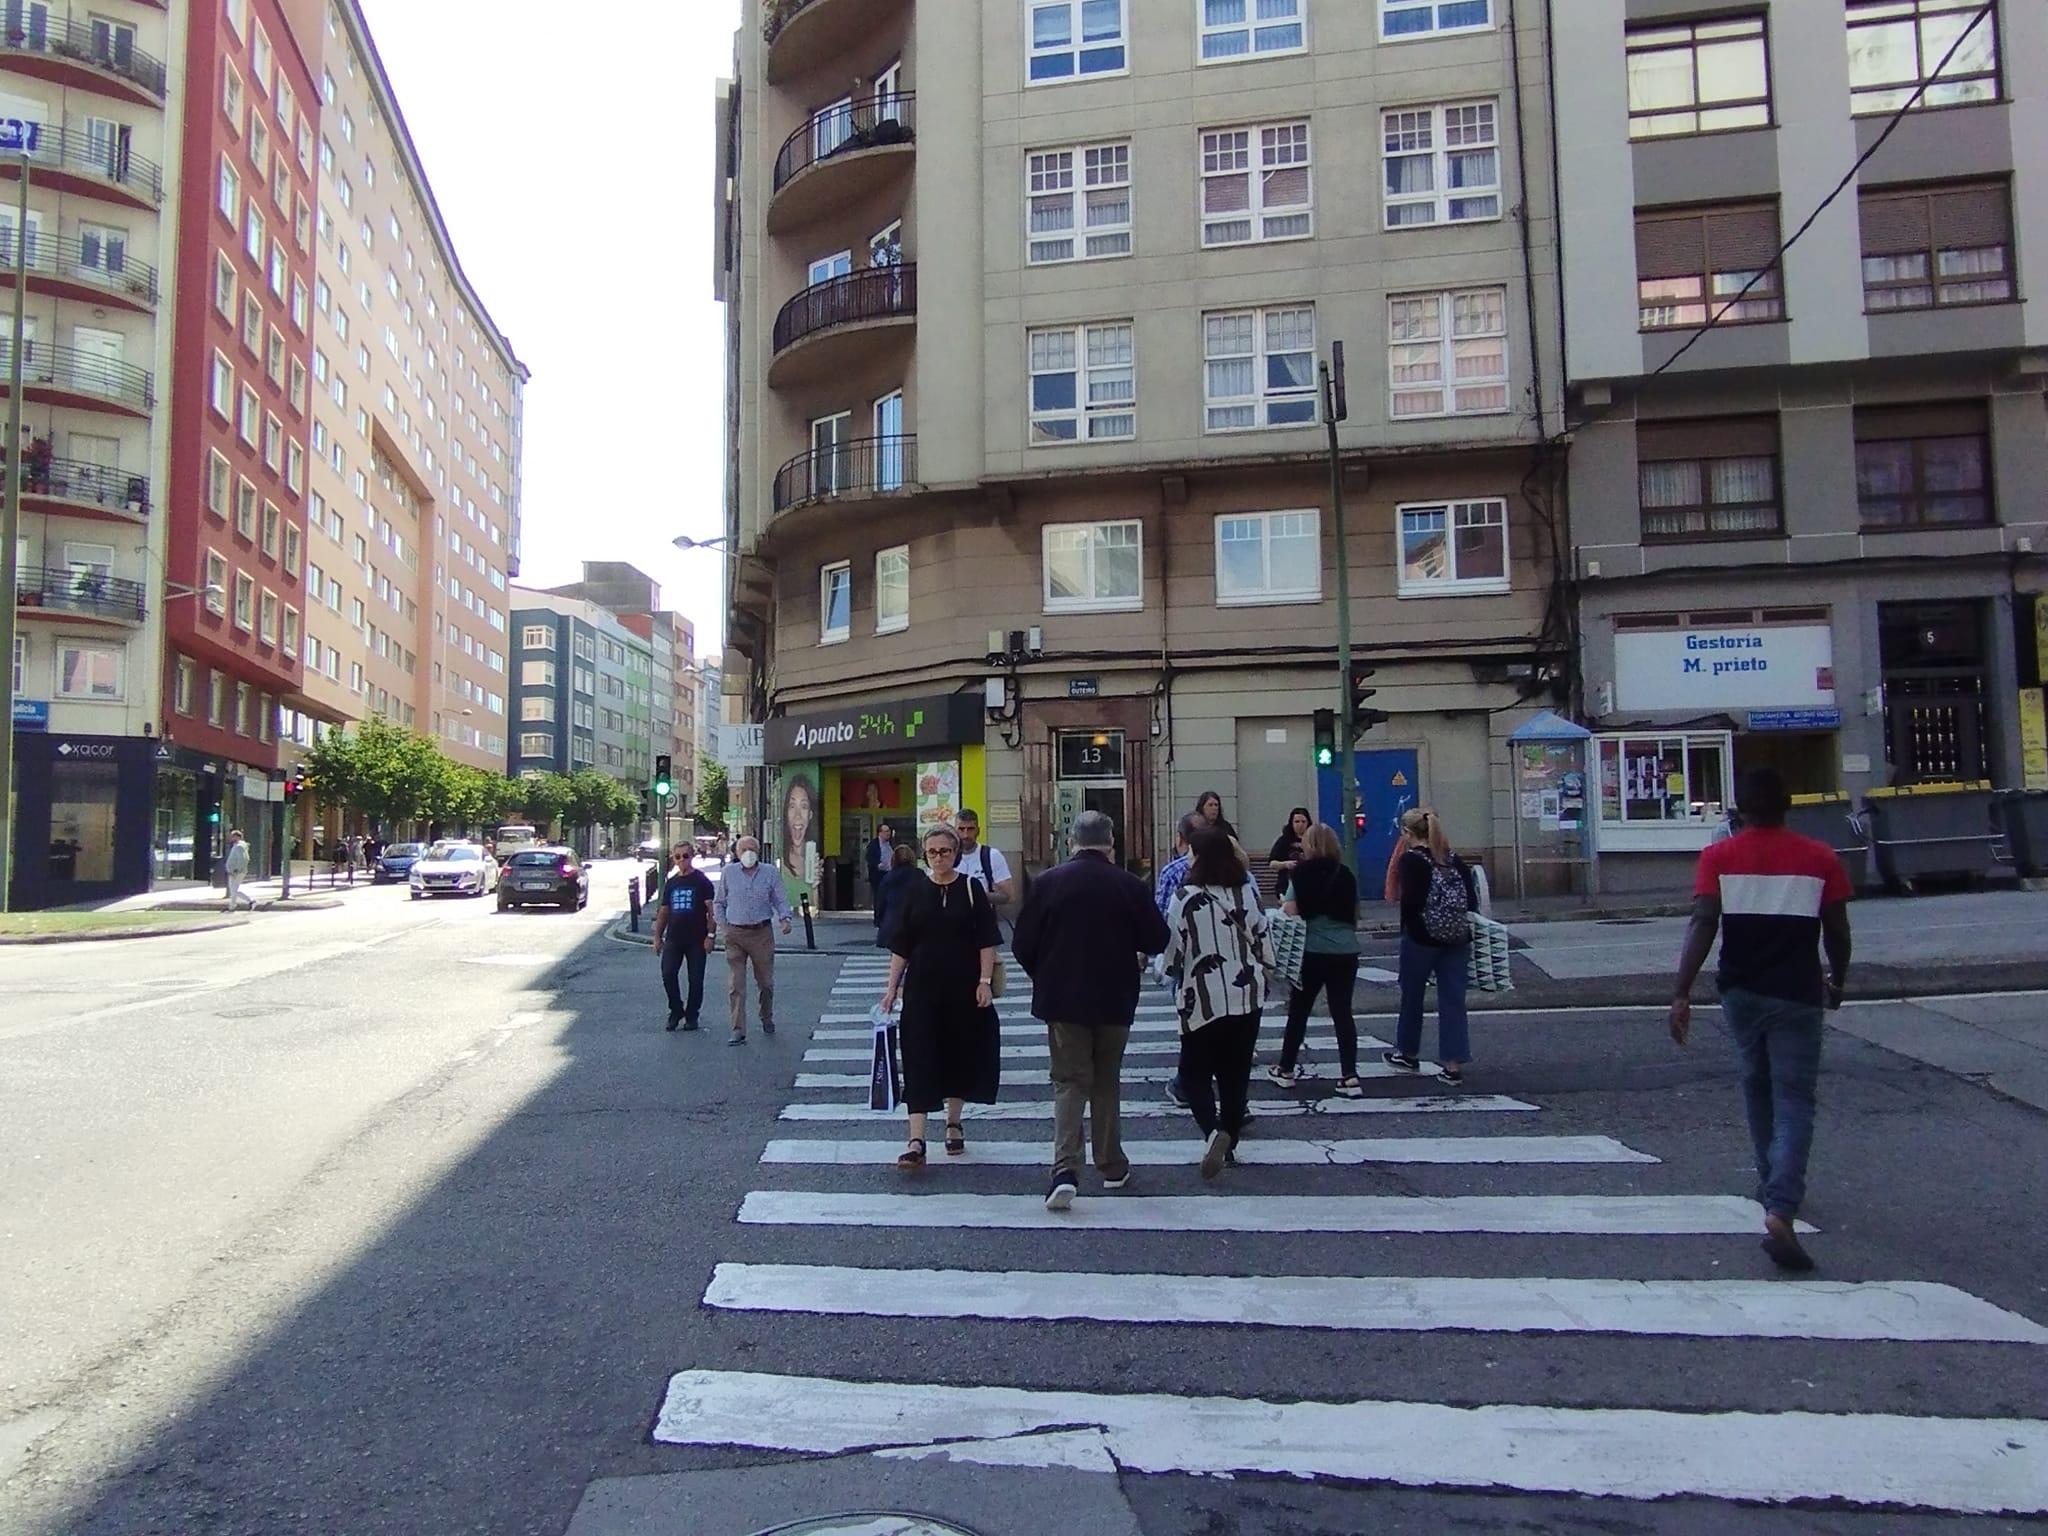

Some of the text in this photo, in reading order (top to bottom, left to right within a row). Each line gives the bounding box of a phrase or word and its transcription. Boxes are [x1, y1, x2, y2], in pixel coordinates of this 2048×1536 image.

[1686, 633, 1763, 650] Gestoría
[1927, 631, 1935, 643] 5
[1683, 657, 1767, 676] M. prieto
[794, 713, 895, 750] Apunto 24h
[72, 744, 114, 757] xacor
[1081, 748, 1102, 763] 13
